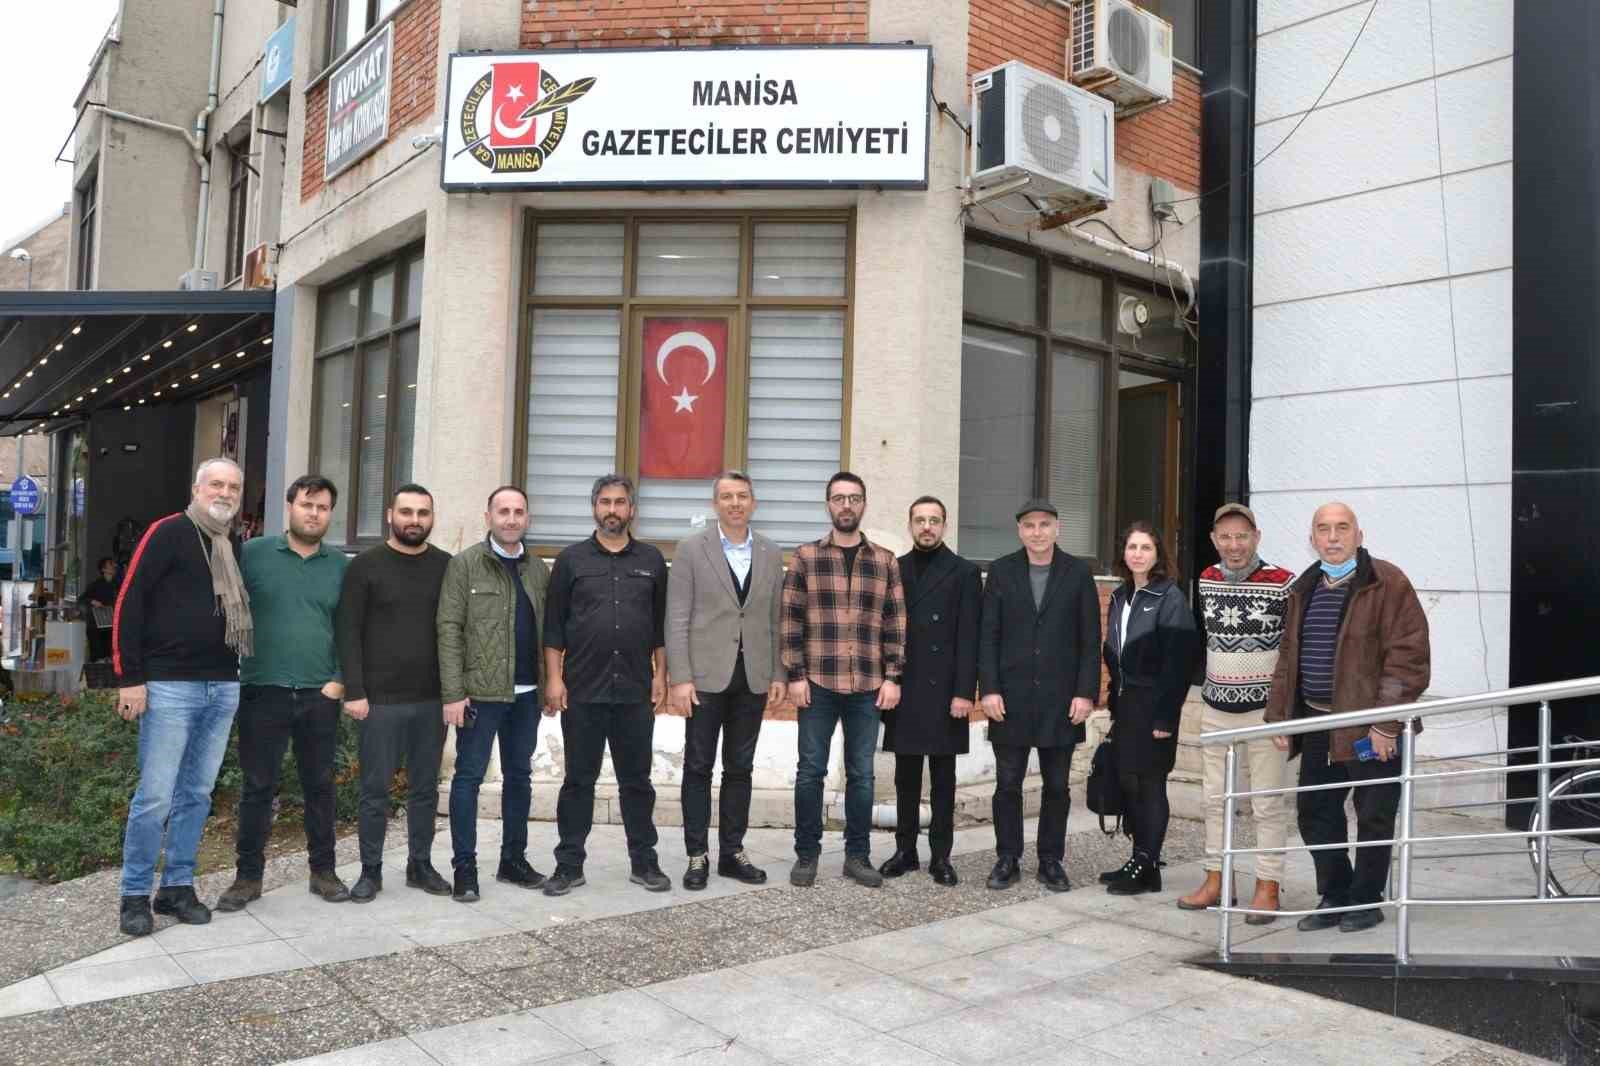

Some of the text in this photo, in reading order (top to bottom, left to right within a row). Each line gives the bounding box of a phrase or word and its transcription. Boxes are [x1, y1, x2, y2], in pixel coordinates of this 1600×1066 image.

[336, 46, 384, 112] AVUKAT
[692, 73, 798, 106] MANİSA
[582, 121, 908, 156] GAZETECİLER CEMİYETİ
[497, 149, 541, 169] MANİSA
